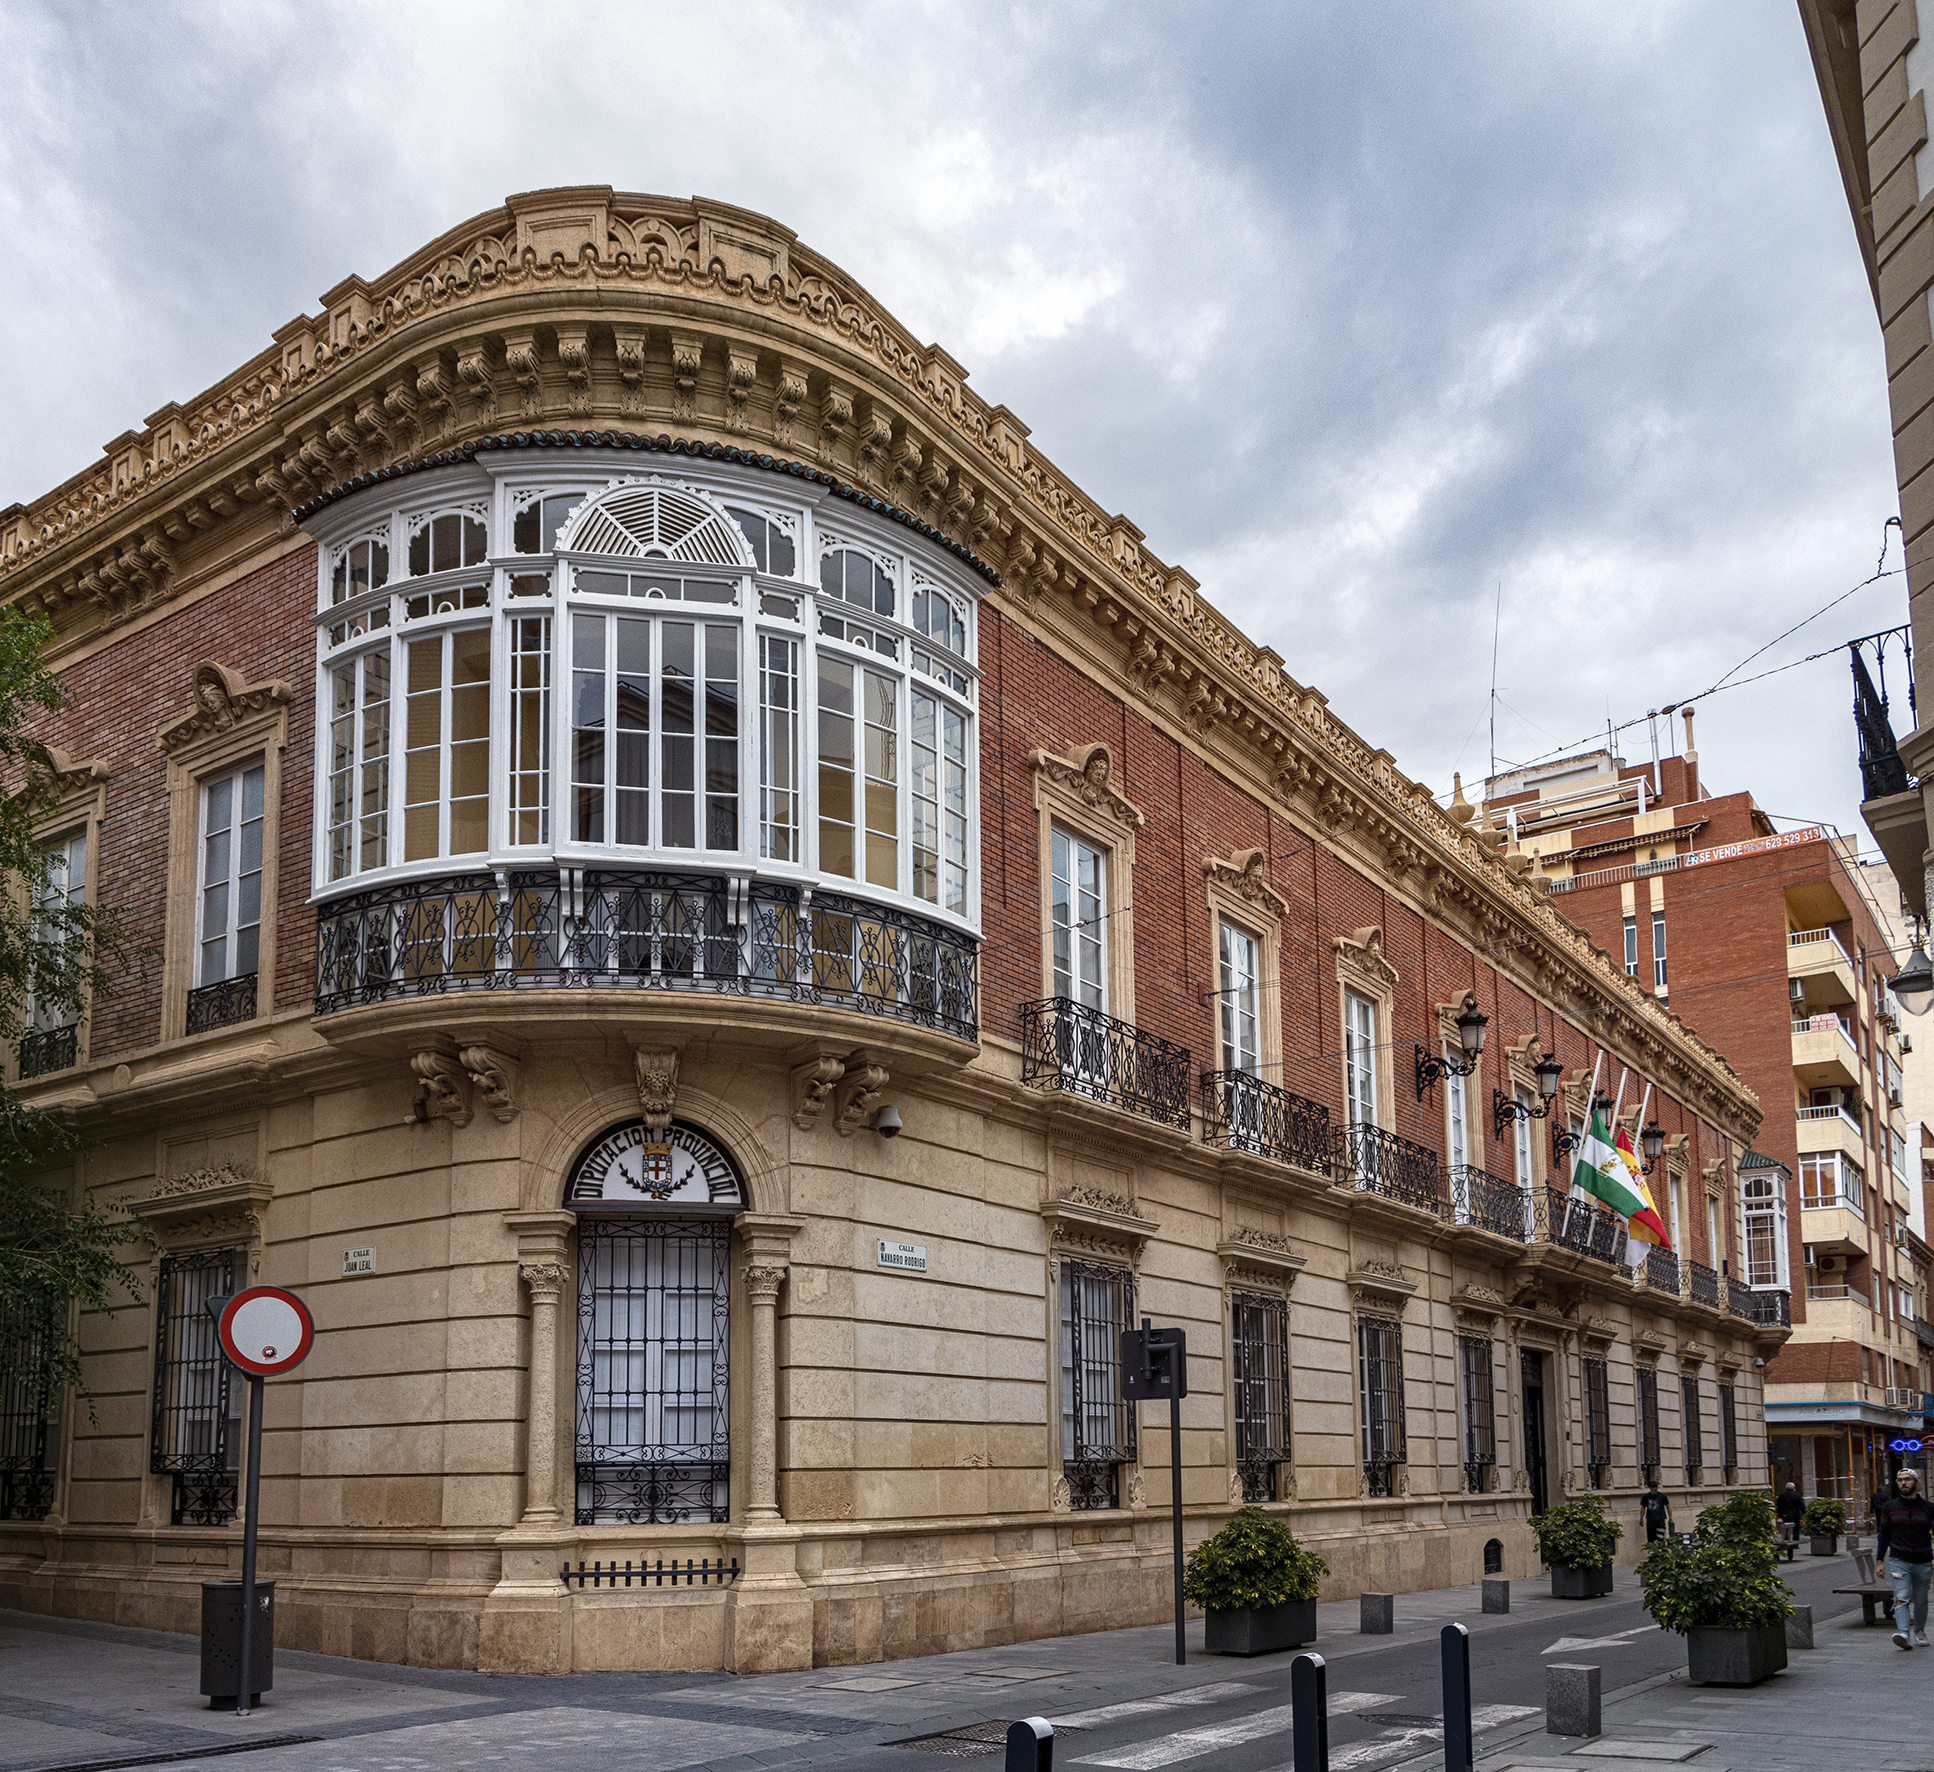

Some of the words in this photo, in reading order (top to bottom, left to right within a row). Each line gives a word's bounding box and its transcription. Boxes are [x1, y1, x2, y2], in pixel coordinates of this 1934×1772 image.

[1699, 851, 1711, 863] SE
[1712, 845, 1743, 860] VENDE
[1765, 837, 1782, 849] 629
[1784, 832, 1801, 846] 529
[1802, 828, 1820, 842] 313
[573, 1126, 655, 1199] DIPUTACION
[662, 1127, 738, 1203] PROVINCIAL
[353, 1250, 370, 1258] CALLE
[898, 1245, 915, 1253] CALLE
[344, 1261, 358, 1273] JUAN
[358, 1260, 372, 1271] LEAL
[881, 1252, 904, 1265] NAVARRO
[904, 1255, 925, 1268] RODRIGO
